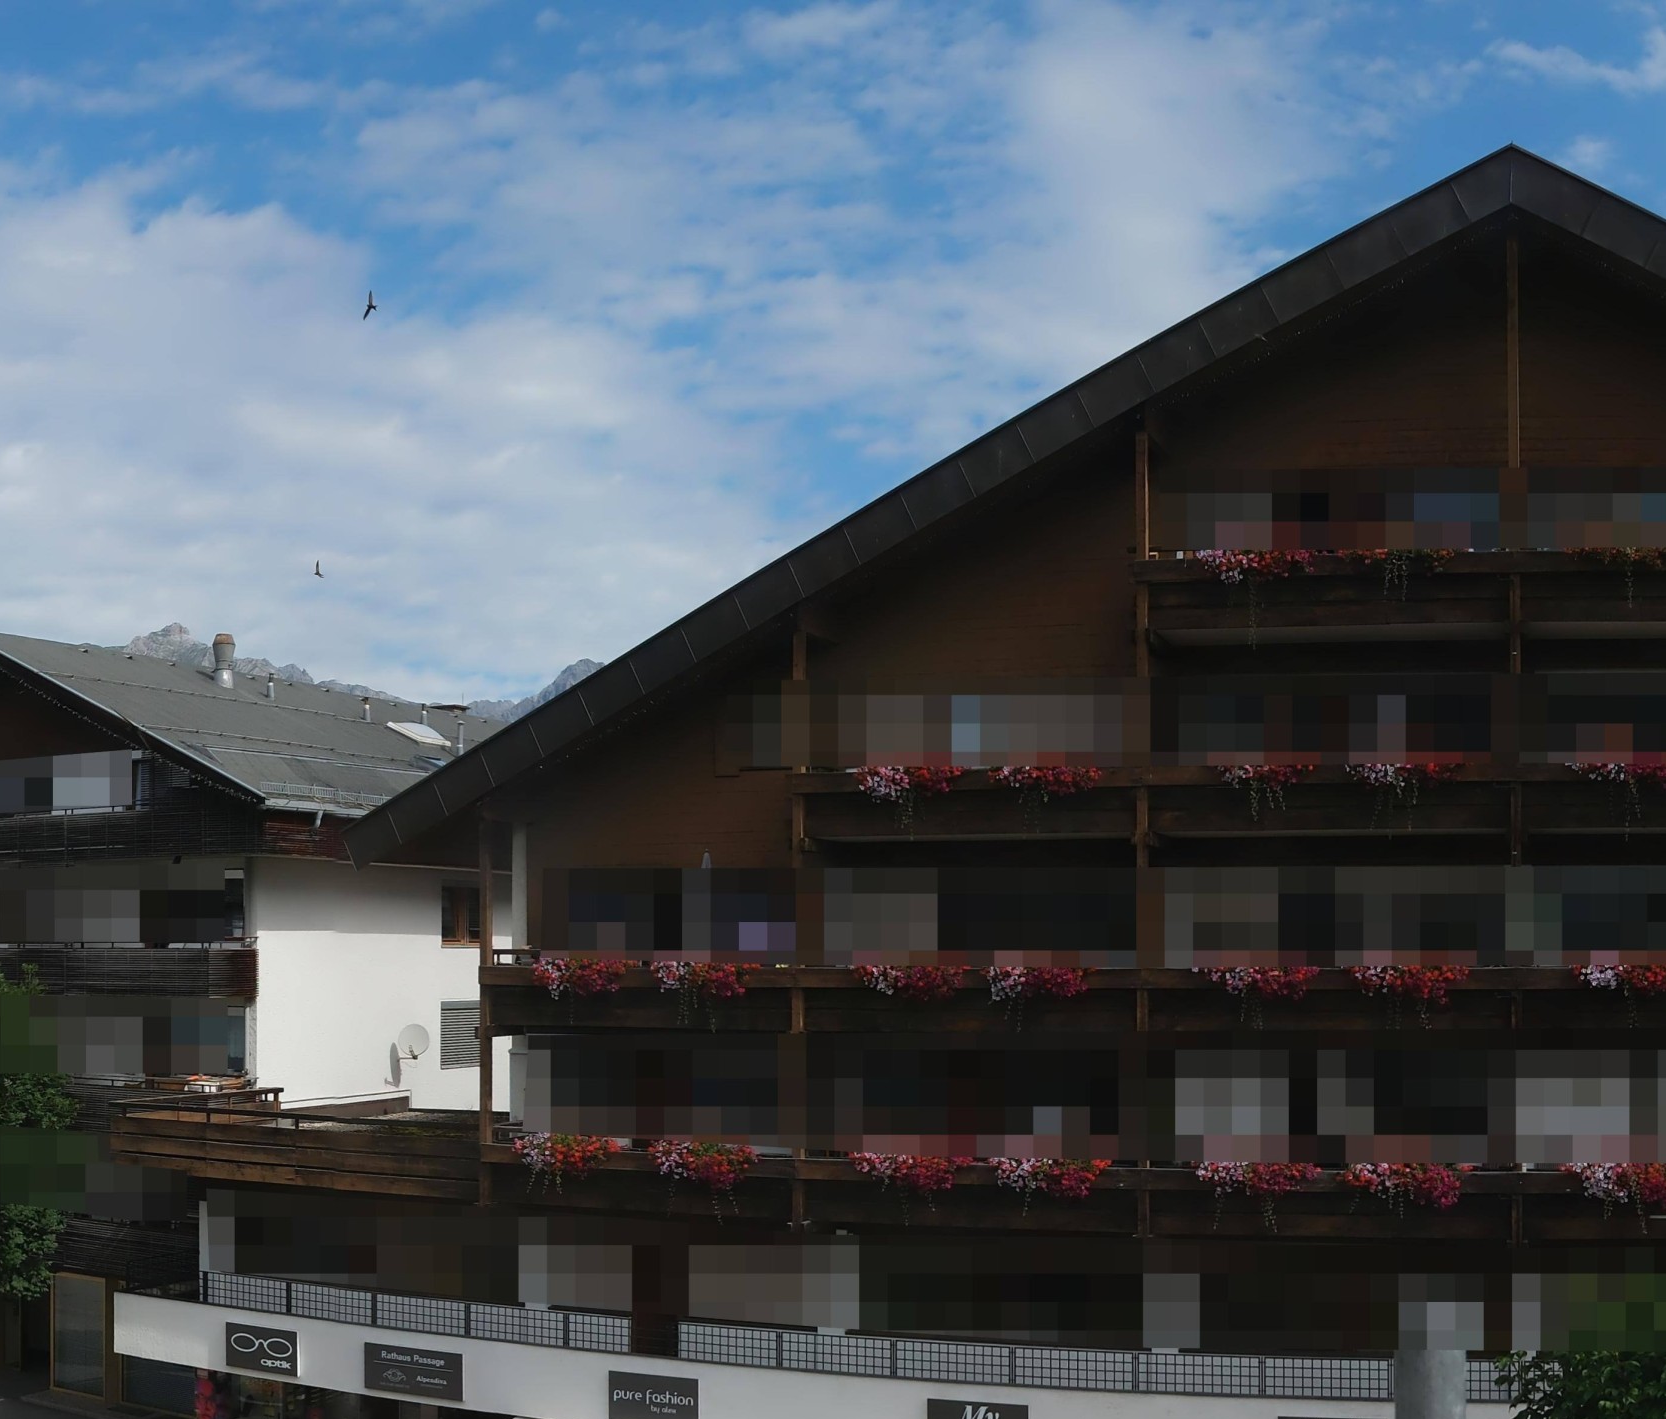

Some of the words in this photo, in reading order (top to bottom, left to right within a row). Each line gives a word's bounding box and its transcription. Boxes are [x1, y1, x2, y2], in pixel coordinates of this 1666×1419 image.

[260, 1358, 292, 1370] optik
[381, 1350, 411, 1362] Rathaus
[413, 1354, 445, 1368] Passage
[613, 1389, 643, 1402] pure
[646, 1389, 694, 1406] fashion
[650, 1404, 660, 1414] by
